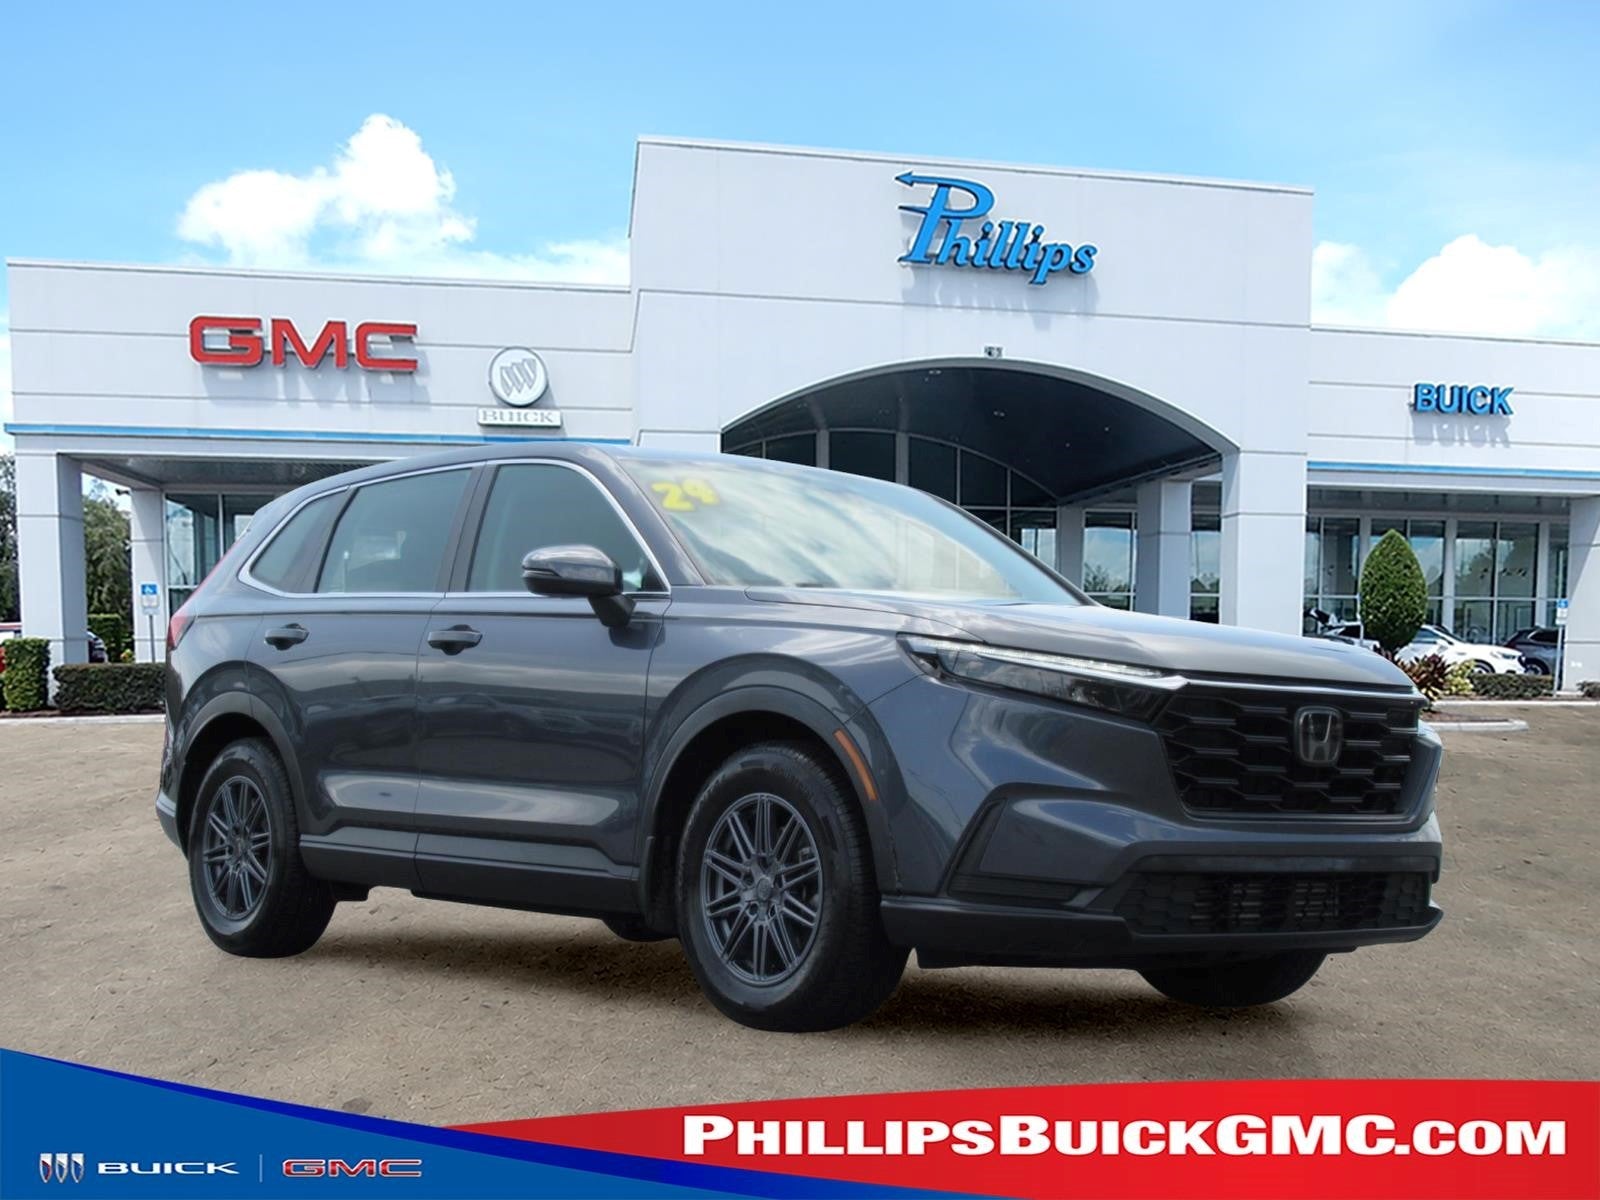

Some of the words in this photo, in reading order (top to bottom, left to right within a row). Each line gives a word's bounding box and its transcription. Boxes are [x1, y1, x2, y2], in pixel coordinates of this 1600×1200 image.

[895, 171, 1098, 285] Phillips
[189, 314, 419, 374] GMC
[481, 410, 554, 423] BUICK
[1412, 382, 1514, 417] BUICK
